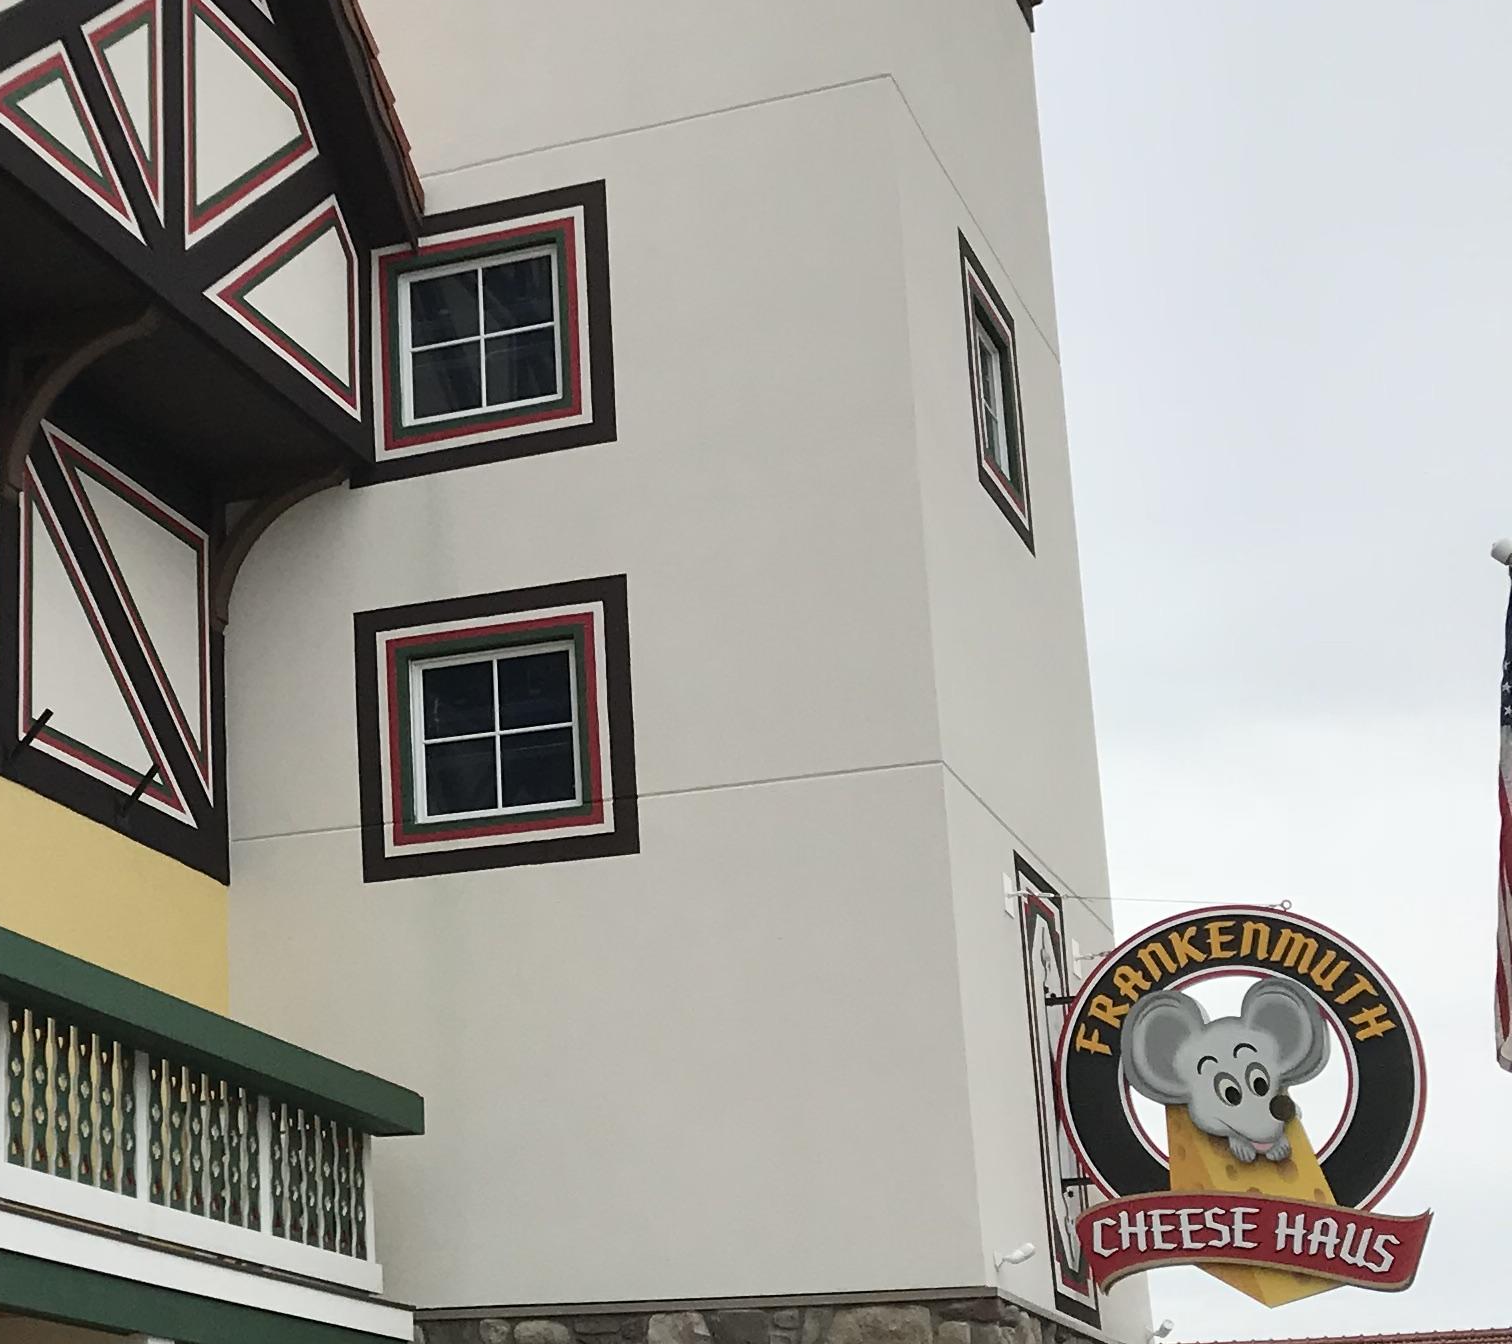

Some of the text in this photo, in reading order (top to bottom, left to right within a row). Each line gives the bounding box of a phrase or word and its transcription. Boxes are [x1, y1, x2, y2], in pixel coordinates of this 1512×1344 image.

[1075, 920, 1397, 1056] FRANKENMUTH
[1092, 1207, 1401, 1273] CHEESE HAUS
